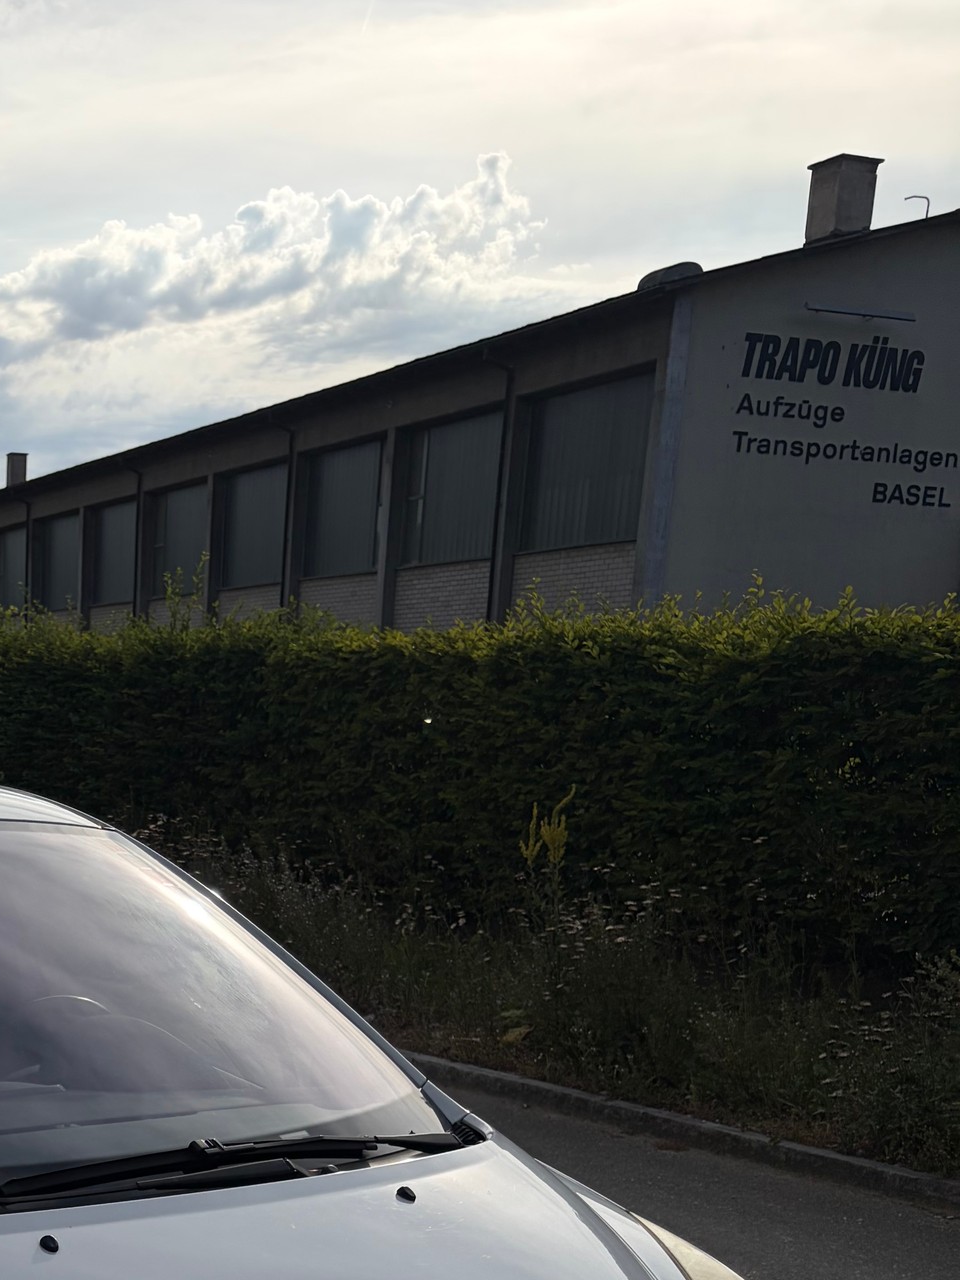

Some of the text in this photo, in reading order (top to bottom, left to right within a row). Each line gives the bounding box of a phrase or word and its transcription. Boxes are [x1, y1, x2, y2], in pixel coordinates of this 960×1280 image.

[741, 332, 925, 393] TRAPO KÜNG
[736, 393, 845, 428] Aufzüge
[732, 431, 959, 472] Transportanlagen
[872, 482, 951, 508] BASEL
